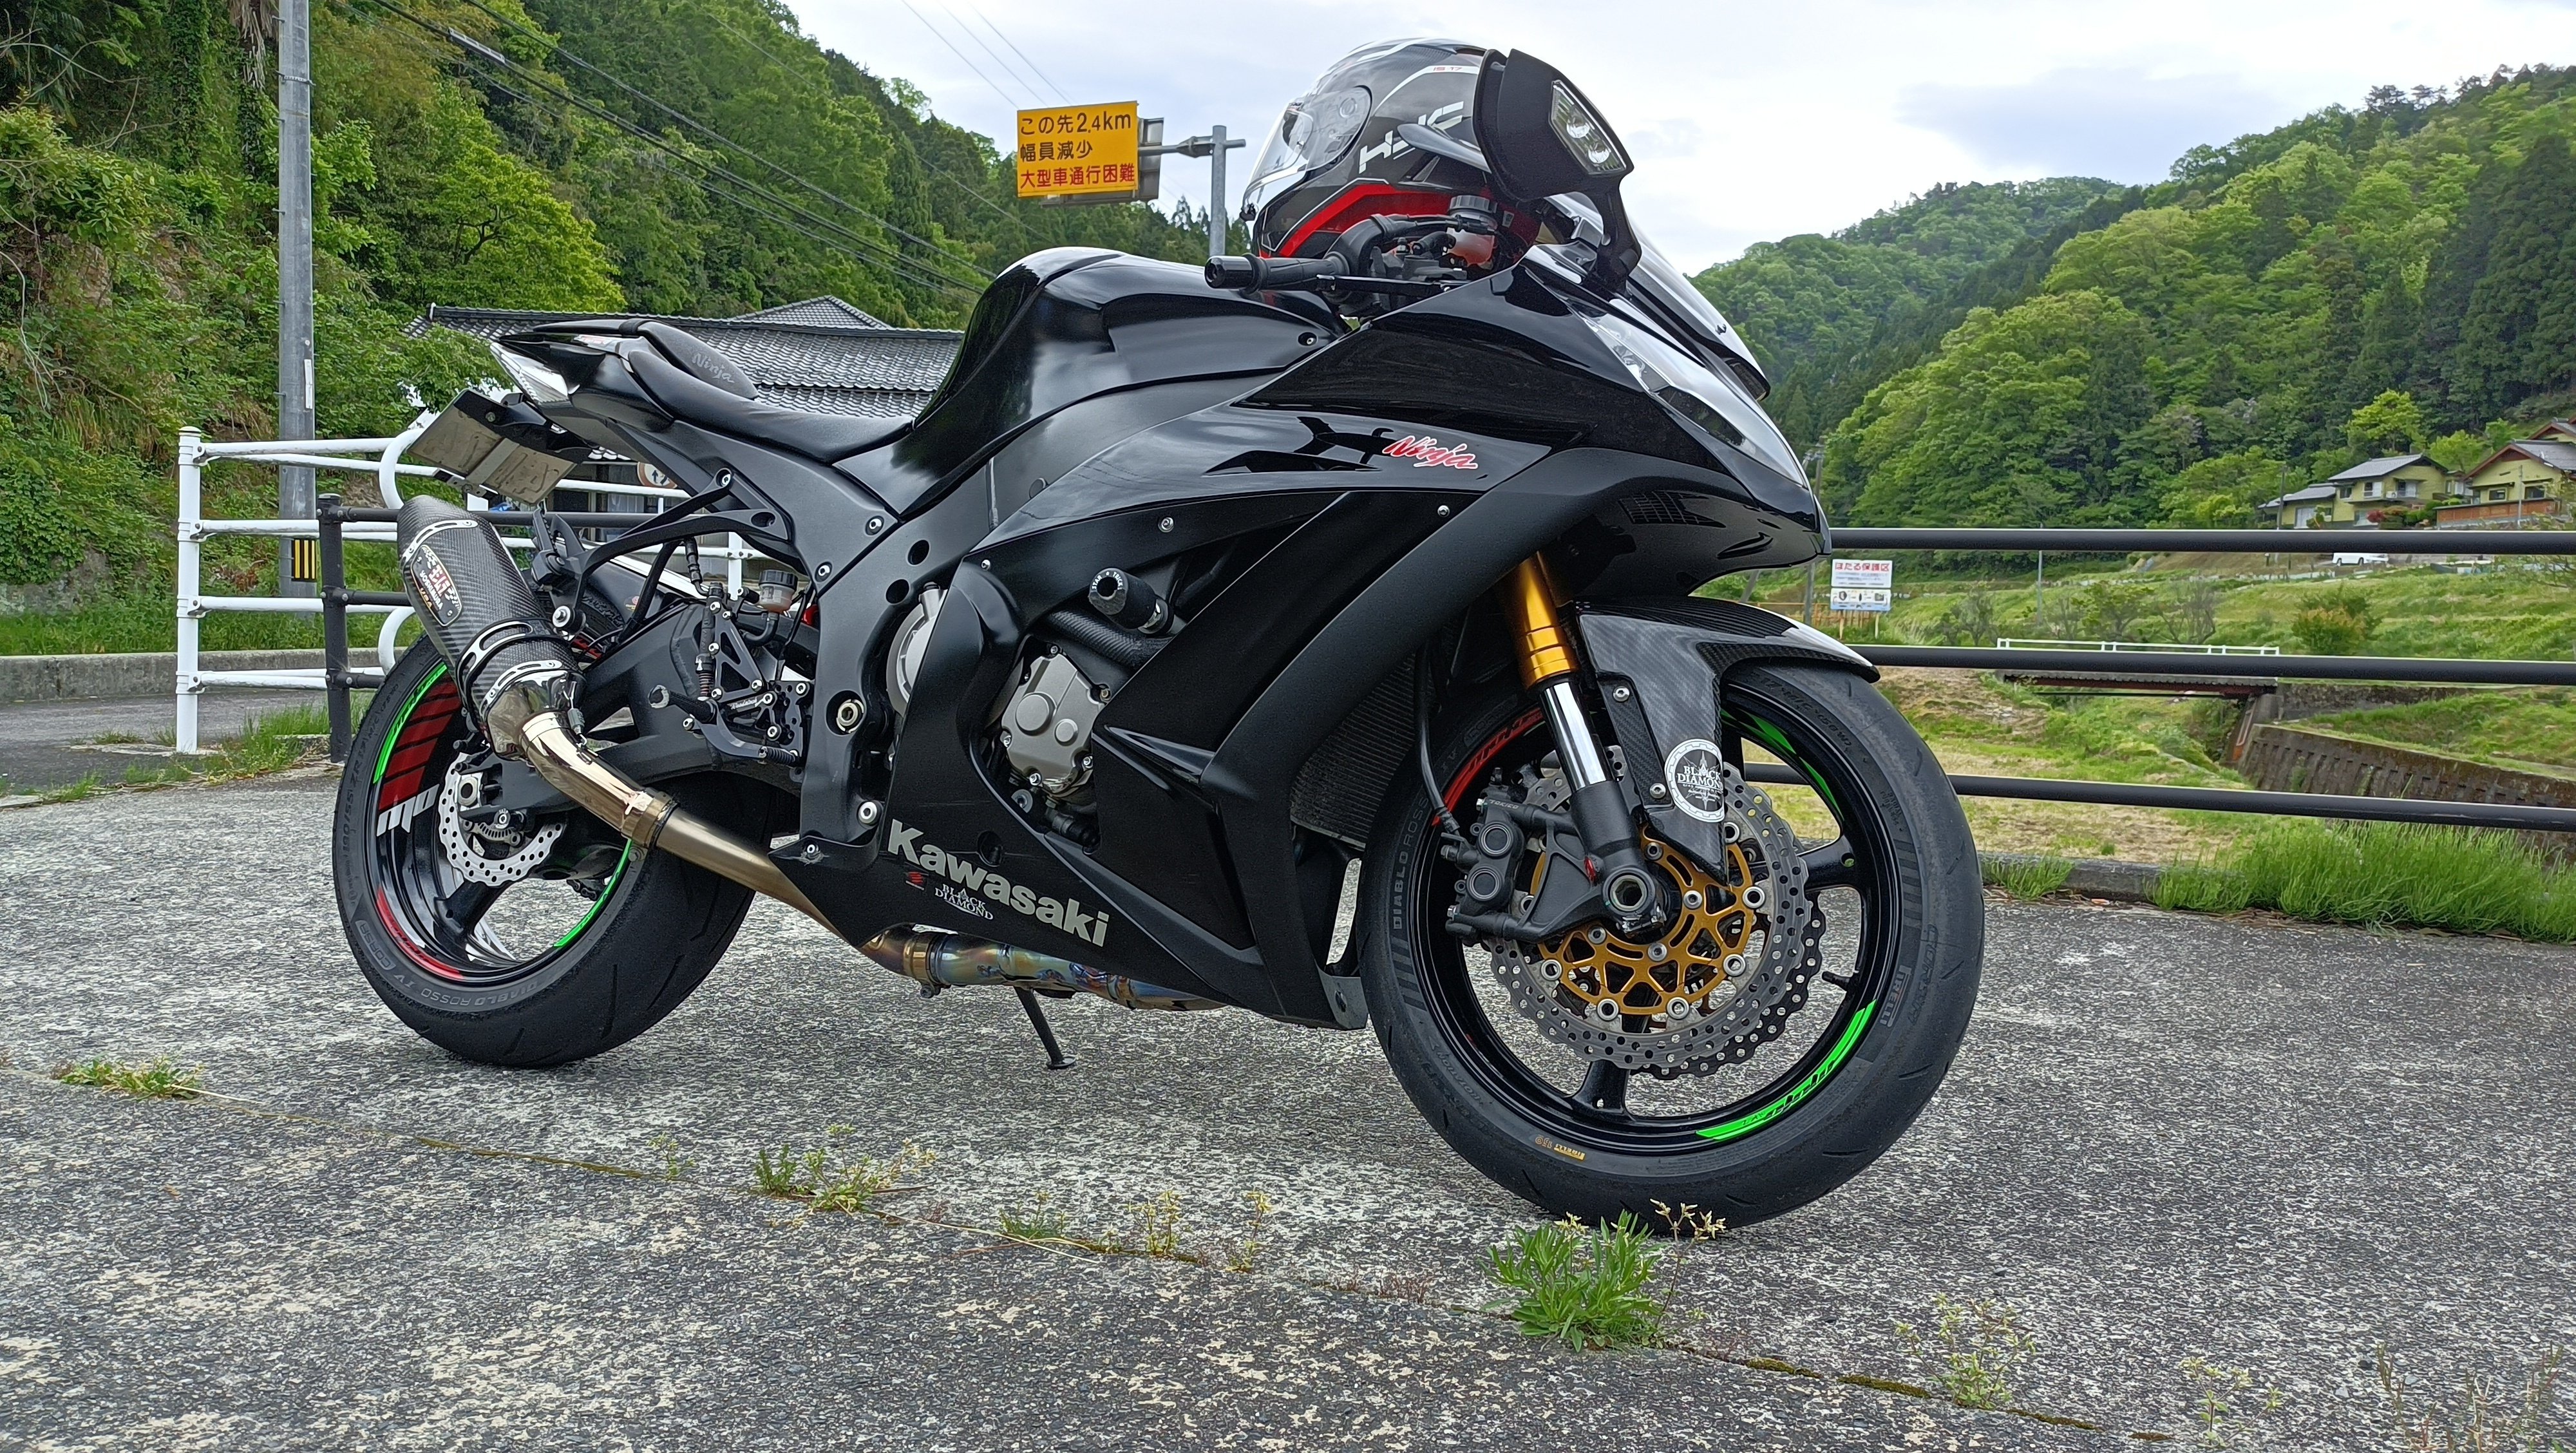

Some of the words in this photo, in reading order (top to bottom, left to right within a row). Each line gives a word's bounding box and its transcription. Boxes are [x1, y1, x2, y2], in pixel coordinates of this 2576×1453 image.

[1021, 111, 1131, 135] この先2.4km
[1020, 139, 1093, 162] 幅員減少
[1020, 163, 1135, 189] 大型車通行困難
[691, 352, 735, 383] Ninja
[1382, 435, 1478, 469] Ninja
[1835, 562, 1889, 572] ほたる保護区
[419, 569, 444, 610] YOSHIMURA
[1092, 575, 1103, 589] STAR
[420, 587, 433, 608] USA
[1677, 773, 1723, 791] DIAMOND
[1683, 763, 1721, 781] BLACK
[1488, 799, 1519, 810] TOKICO
[1392, 851, 1409, 929] DIABLO
[1403, 797, 1429, 847] ROSS
[887, 819, 1110, 947] Kawasaki
[934, 888, 994, 920] DIAMOND
[942, 884, 987, 910] BLACK
[360, 923, 391, 968] CORSA
[393, 974, 416, 989] IV
[474, 981, 538, 1006] DIABLO
[421, 987, 471, 1006] ROSSO
[1879, 965, 1912, 1027] PIRELLI
